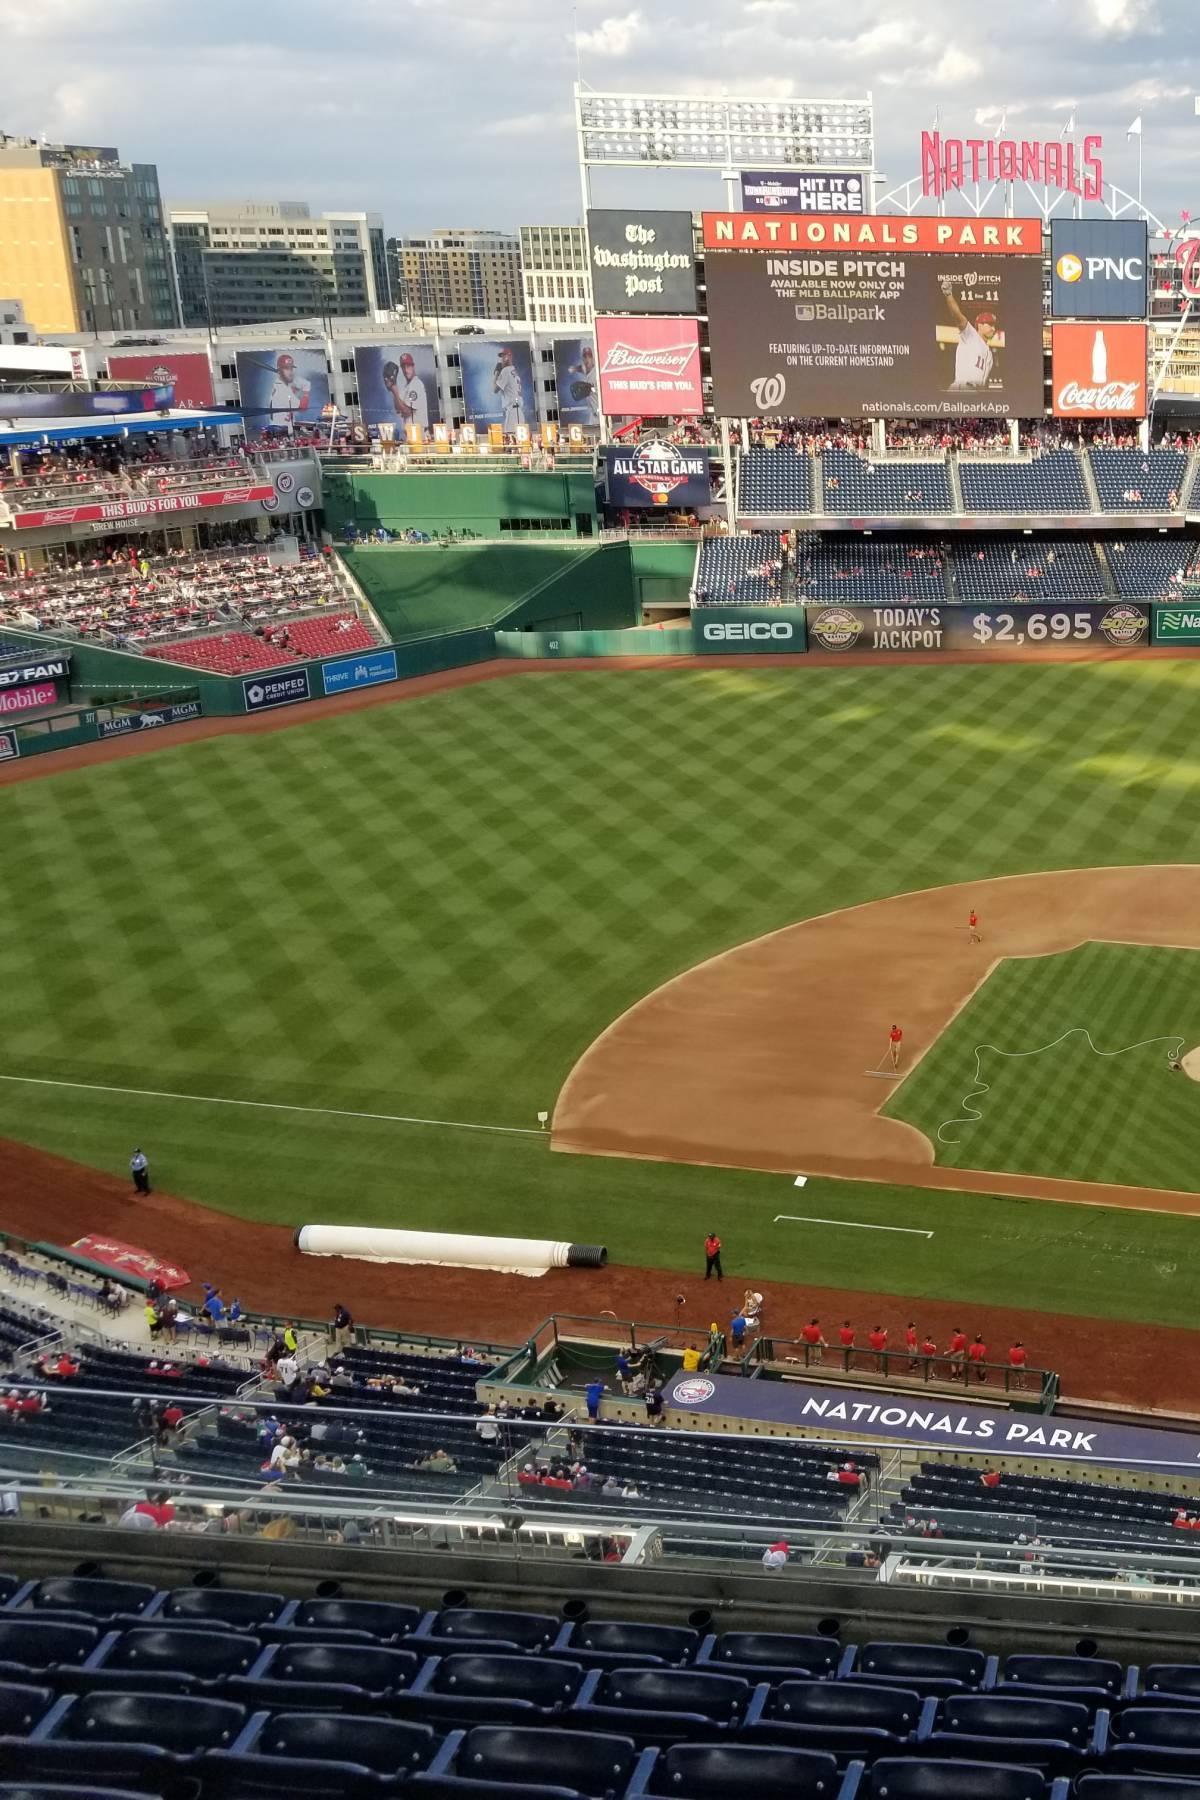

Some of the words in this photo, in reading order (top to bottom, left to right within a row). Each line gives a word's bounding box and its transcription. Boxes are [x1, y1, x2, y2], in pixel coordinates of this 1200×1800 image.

[921, 130, 1103, 201] NATIONALS
[799, 178, 827, 192] HIT
[829, 179, 845, 192] IT
[800, 192, 862, 211] HERE
[624, 223, 656, 245] The
[715, 219, 919, 245] NATIONALS
[937, 225, 1024, 246] PARK
[593, 244, 691, 273] Washington
[766, 259, 839, 276] INSIDE
[843, 260, 906, 278] PITCH
[1085, 257, 1143, 281] PNC
[625, 275, 664, 297] Post
[770, 279, 828, 289] AVAILABLE
[830, 280, 856, 289] NOW
[858, 281, 886, 290] ONLY
[888, 281, 905, 291] ON
[937, 274, 963, 282] INSIDE
[978, 275, 1001, 283] PITCH
[775, 289, 797, 298] THE
[799, 289, 820, 298] MLB
[823, 290, 877, 299] BALLPARK
[879, 290, 901, 300] APP
[815, 303, 886, 323] Ballpark
[607, 348, 688, 366] Budweiser
[768, 343, 811, 354] FEATURING
[811, 344, 858, 355] UP-TO-DATE
[859, 344, 910, 356] INFORMATION
[786, 355, 798, 366] ON
[799, 355, 814, 366] THE
[814, 356, 848, 367] CURRENT
[849, 356, 894, 367] HOMESTAND
[607, 380, 630, 391] THIS
[629, 380, 656, 391] BUD'S
[656, 380, 674, 391] FOR
[1057, 380, 1141, 411] Coca-Cola
[861, 401, 1010, 414] nationals.com/BallparkApp
[613, 459, 637, 475] ALL
[637, 460, 670, 475] STAR
[670, 460, 704, 475] GAME
[101, 502, 125, 517] THIS
[126, 500, 157, 516] BUD'S
[158, 498, 177, 511] FOR
[178, 495, 202, 510] YOU.
[92, 520, 114, 532] BREW
[115, 518, 139, 529] HOUSE
[872, 608, 940, 627] TODAY'S
[1101, 617, 1148, 630] 50/50
[703, 622, 793, 640] GEICO
[812, 621, 864, 634] 50/50
[972, 612, 1092, 646] $2,695
[872, 629, 944, 649] JACKPOT
[23, 662, 63, 680] FAN
[325, 672, 349, 684] THRIVE
[264, 678, 305, 694] PENFED
[265, 691, 287, 700] CREDIT
[287, 687, 305, 697] UNION
[171, 703, 198, 717] MGM
[103, 718, 131, 732] MGM
[800, 1397, 995, 1438] NATIONALS
[1004, 1422, 1099, 1453] PARK
